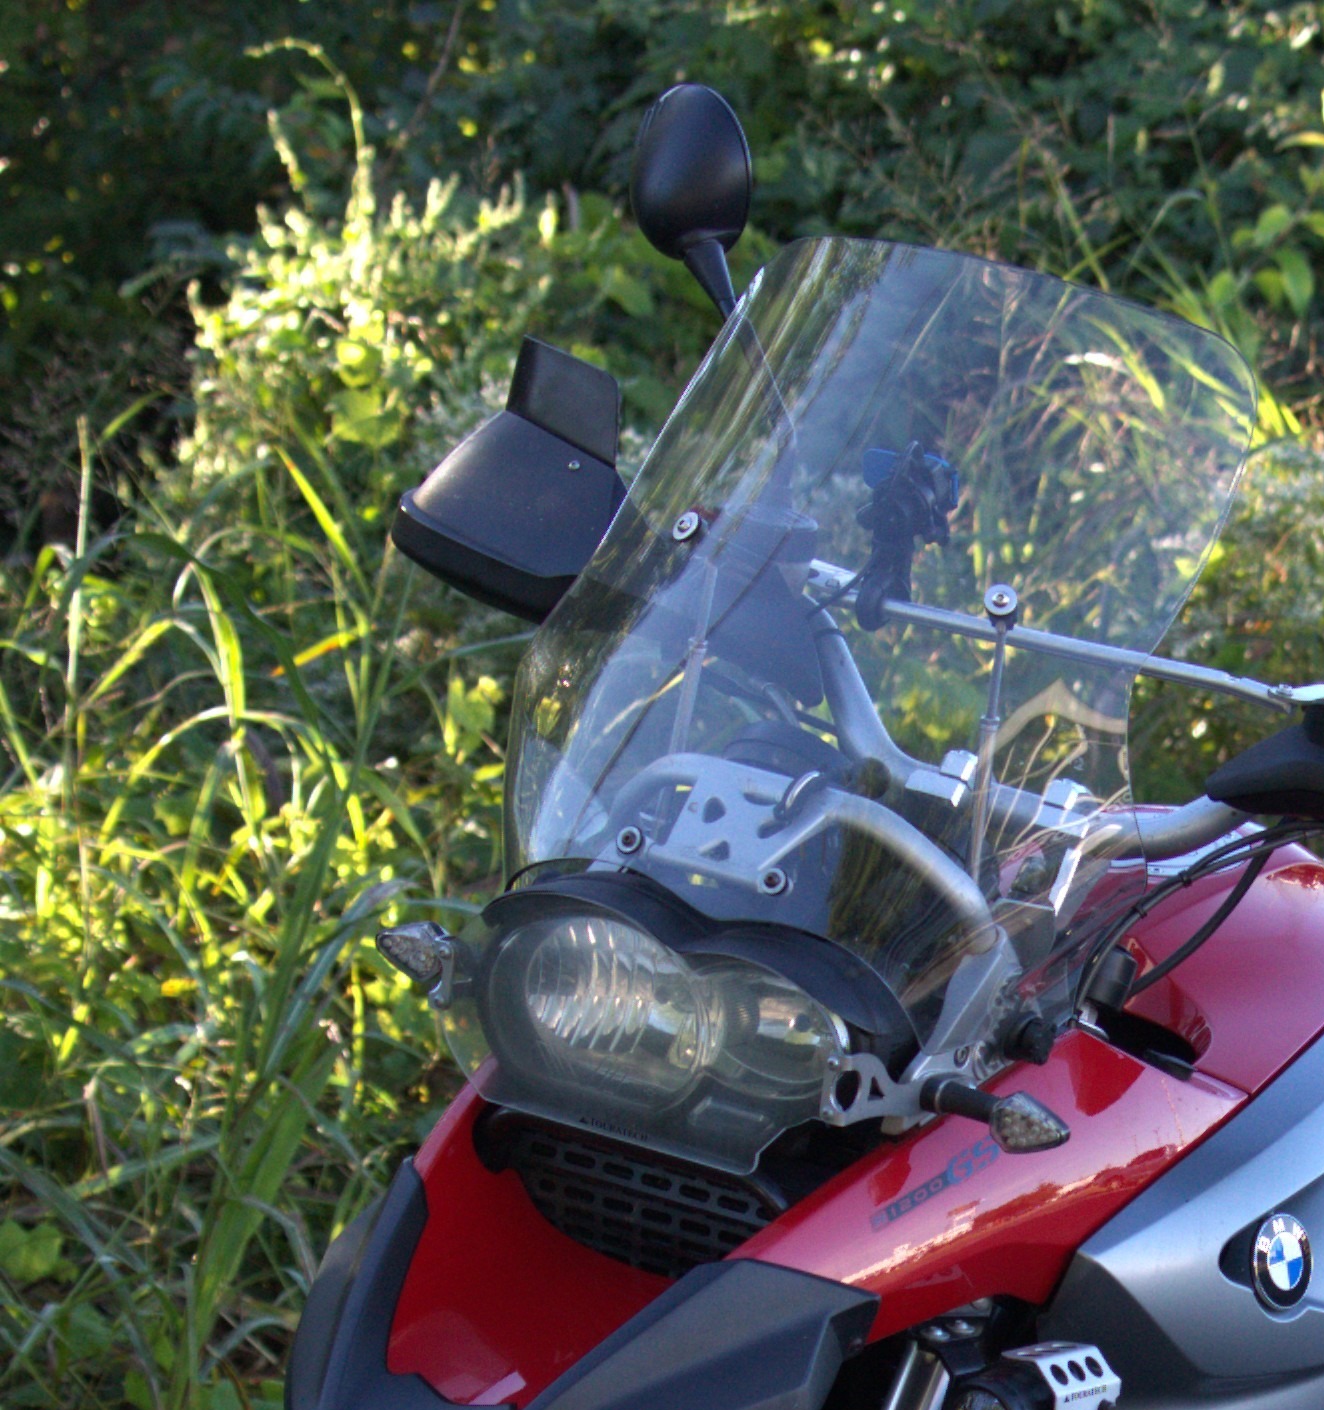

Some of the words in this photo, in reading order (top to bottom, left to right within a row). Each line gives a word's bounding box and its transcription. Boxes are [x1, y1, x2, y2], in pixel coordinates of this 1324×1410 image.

[890, 1177, 943, 1219] 1200
[946, 1135, 1000, 1185] GS
[1257, 1217, 1307, 1254] BMW
